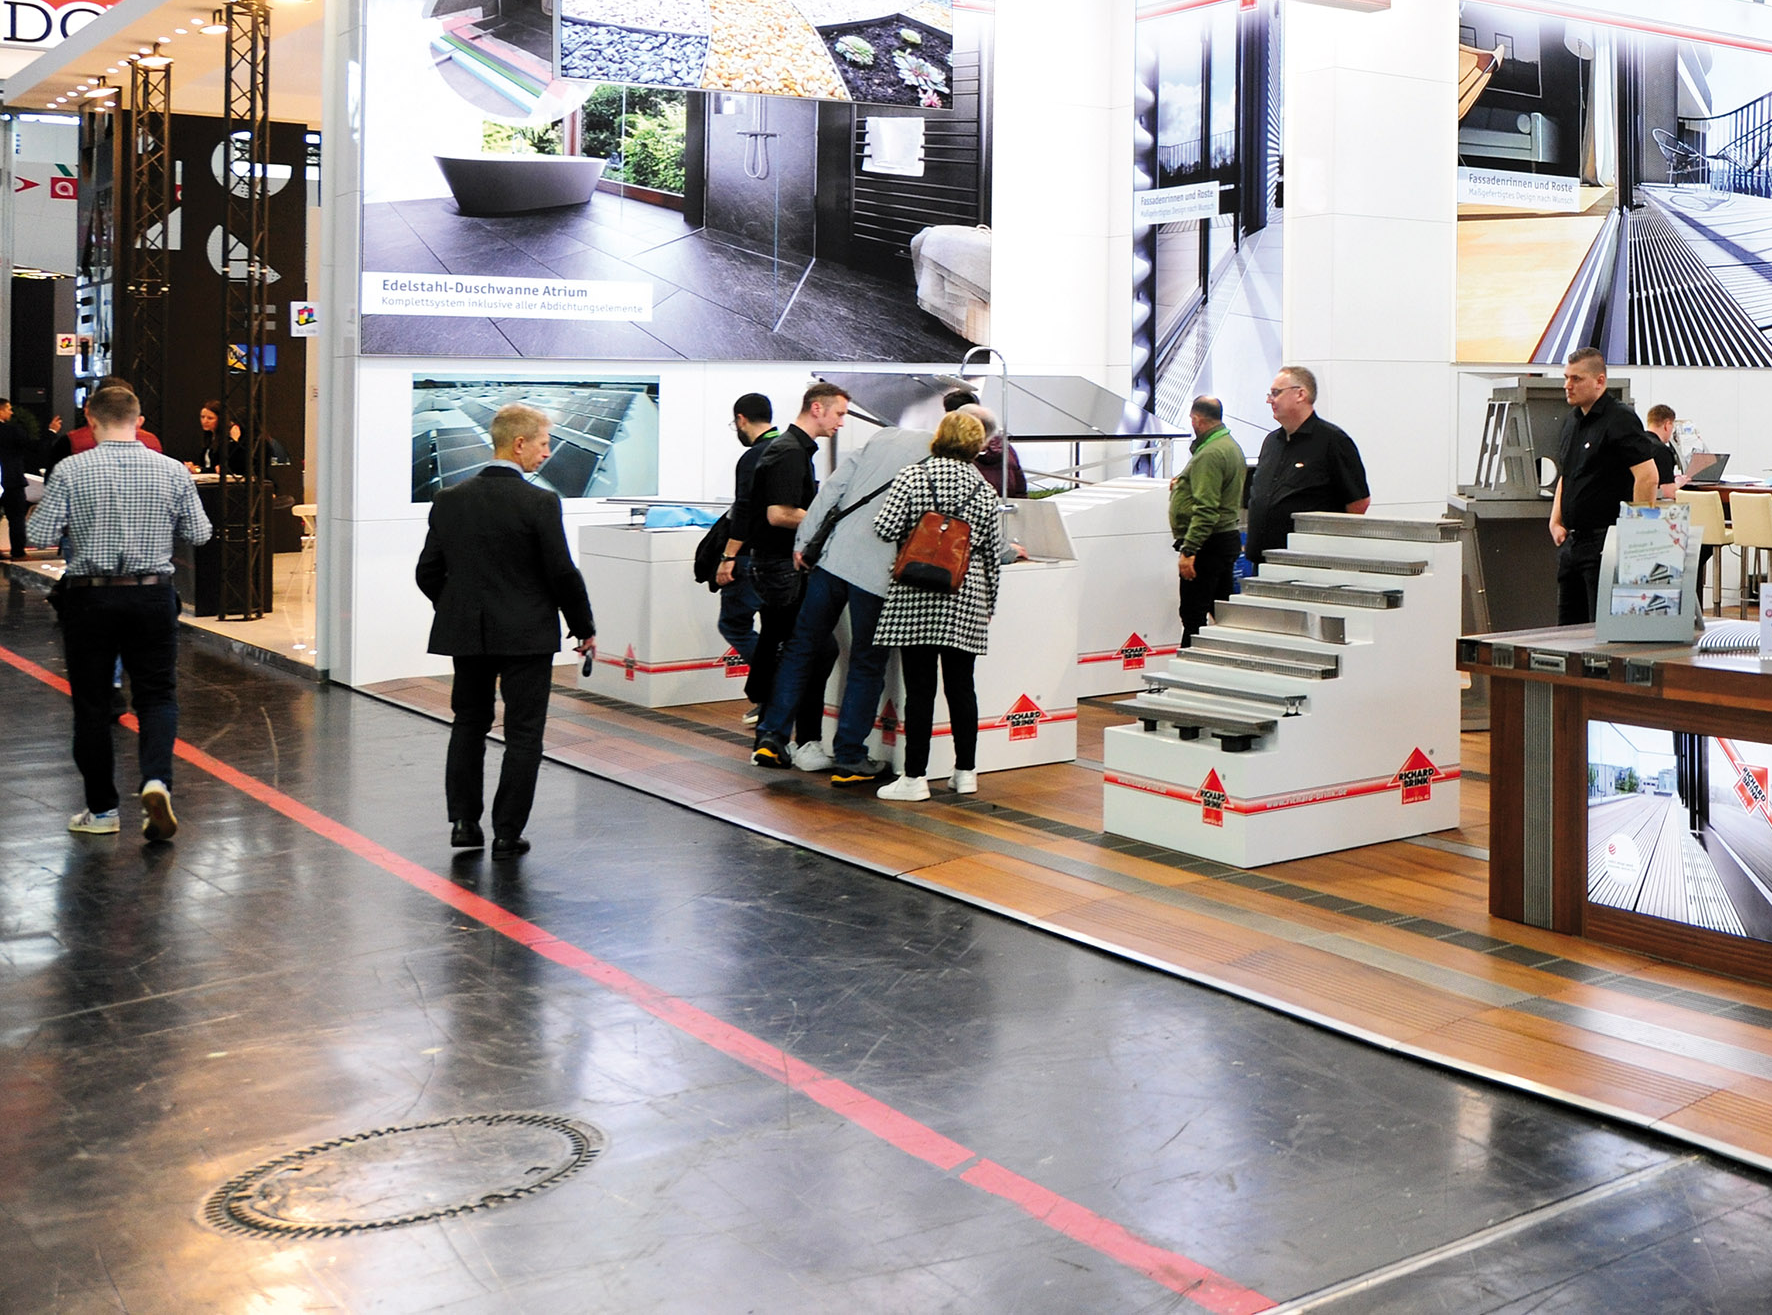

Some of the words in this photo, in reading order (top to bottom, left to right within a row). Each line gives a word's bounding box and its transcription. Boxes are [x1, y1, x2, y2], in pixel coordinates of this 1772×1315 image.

[1469, 173, 1533, 189] Fassadenrinnen
[1535, 180, 1549, 190] und
[1551, 181, 1573, 193] Roste
[382, 279, 539, 297] Edelstahl-Duschwanne
[542, 284, 588, 298] Atrium
[381, 296, 465, 311] Komplettsystem
[468, 297, 512, 310] inklusive
[515, 299, 537, 311] aller
[540, 300, 643, 315] Abdichtungselemente
[1006, 711, 1040, 721] RICHARD
[1011, 719, 1035, 727] BRINK
[1399, 768, 1434, 781] RICHARD
[1403, 778, 1428, 788] BRINK
[1743, 767, 1766, 801] RICHARD
[1742, 776, 1759, 802] BRINK
